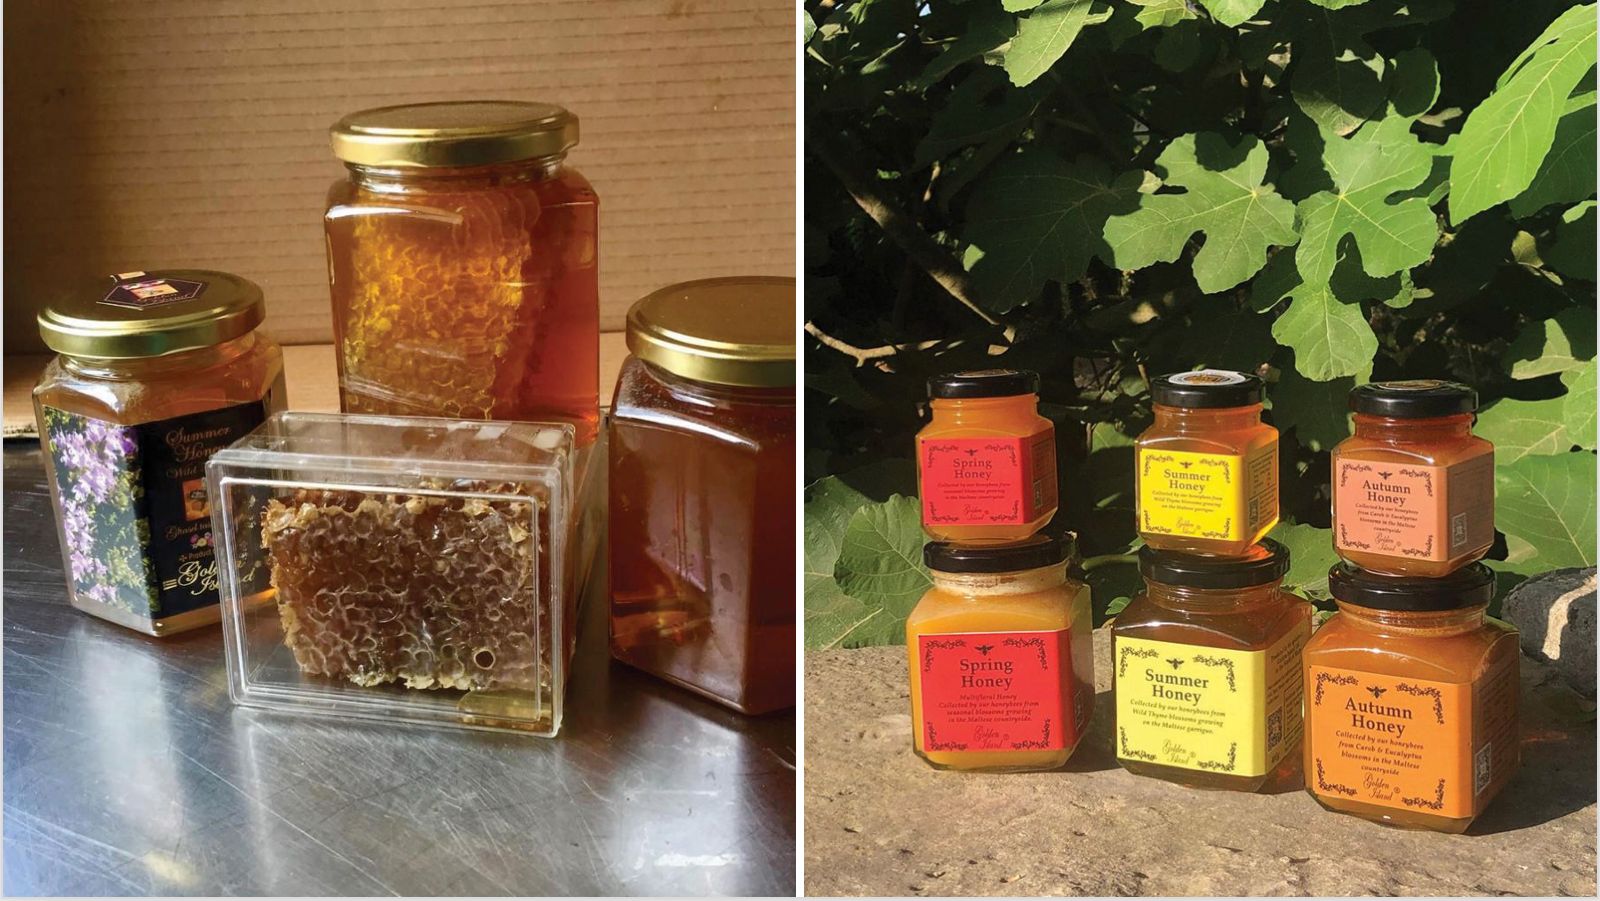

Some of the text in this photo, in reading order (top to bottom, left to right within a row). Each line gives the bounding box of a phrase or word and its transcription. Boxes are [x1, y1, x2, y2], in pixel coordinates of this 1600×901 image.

[166, 426, 231, 445] Summer
[953, 458, 992, 469] Spring
[955, 470, 991, 480] Honey
[1164, 469, 1211, 481] Summer
[1169, 480, 1205, 492] Honey
[1363, 480, 1411, 494] Autumn
[1367, 492, 1406, 507] Honey
[960, 658, 1013, 674] Spring
[962, 676, 1013, 690] Honey
[1145, 669, 1209, 688] Summer
[1152, 685, 1201, 706] Honey
[1130, 699, 1157, 708] Collected
[1179, 706, 1209, 715] honeybees
[1210, 710, 1226, 718] from
[1345, 697, 1412, 719] Autumn
[1132, 708, 1223, 728] Wild Thyme blossoms growing
[1162, 722, 1186, 730] Maltese
[1352, 714, 1405, 738] Honey
[1162, 739, 1187, 754] Golden
[1336, 730, 1365, 740] Collected
[1367, 734, 1375, 743] by
[1390, 738, 1424, 750] honeybees
[1338, 741, 1354, 750] from
[1356, 744, 1375, 752] Carob
[1385, 748, 1422, 760] Eucalyptus
[1341, 751, 1372, 762] blossoms
[1382, 757, 1392, 765] the
[1394, 759, 1420, 769] Maltese
[1361, 765, 1399, 776] countryside
[1363, 773, 1389, 790] Golden
[1368, 787, 1393, 801] Island
